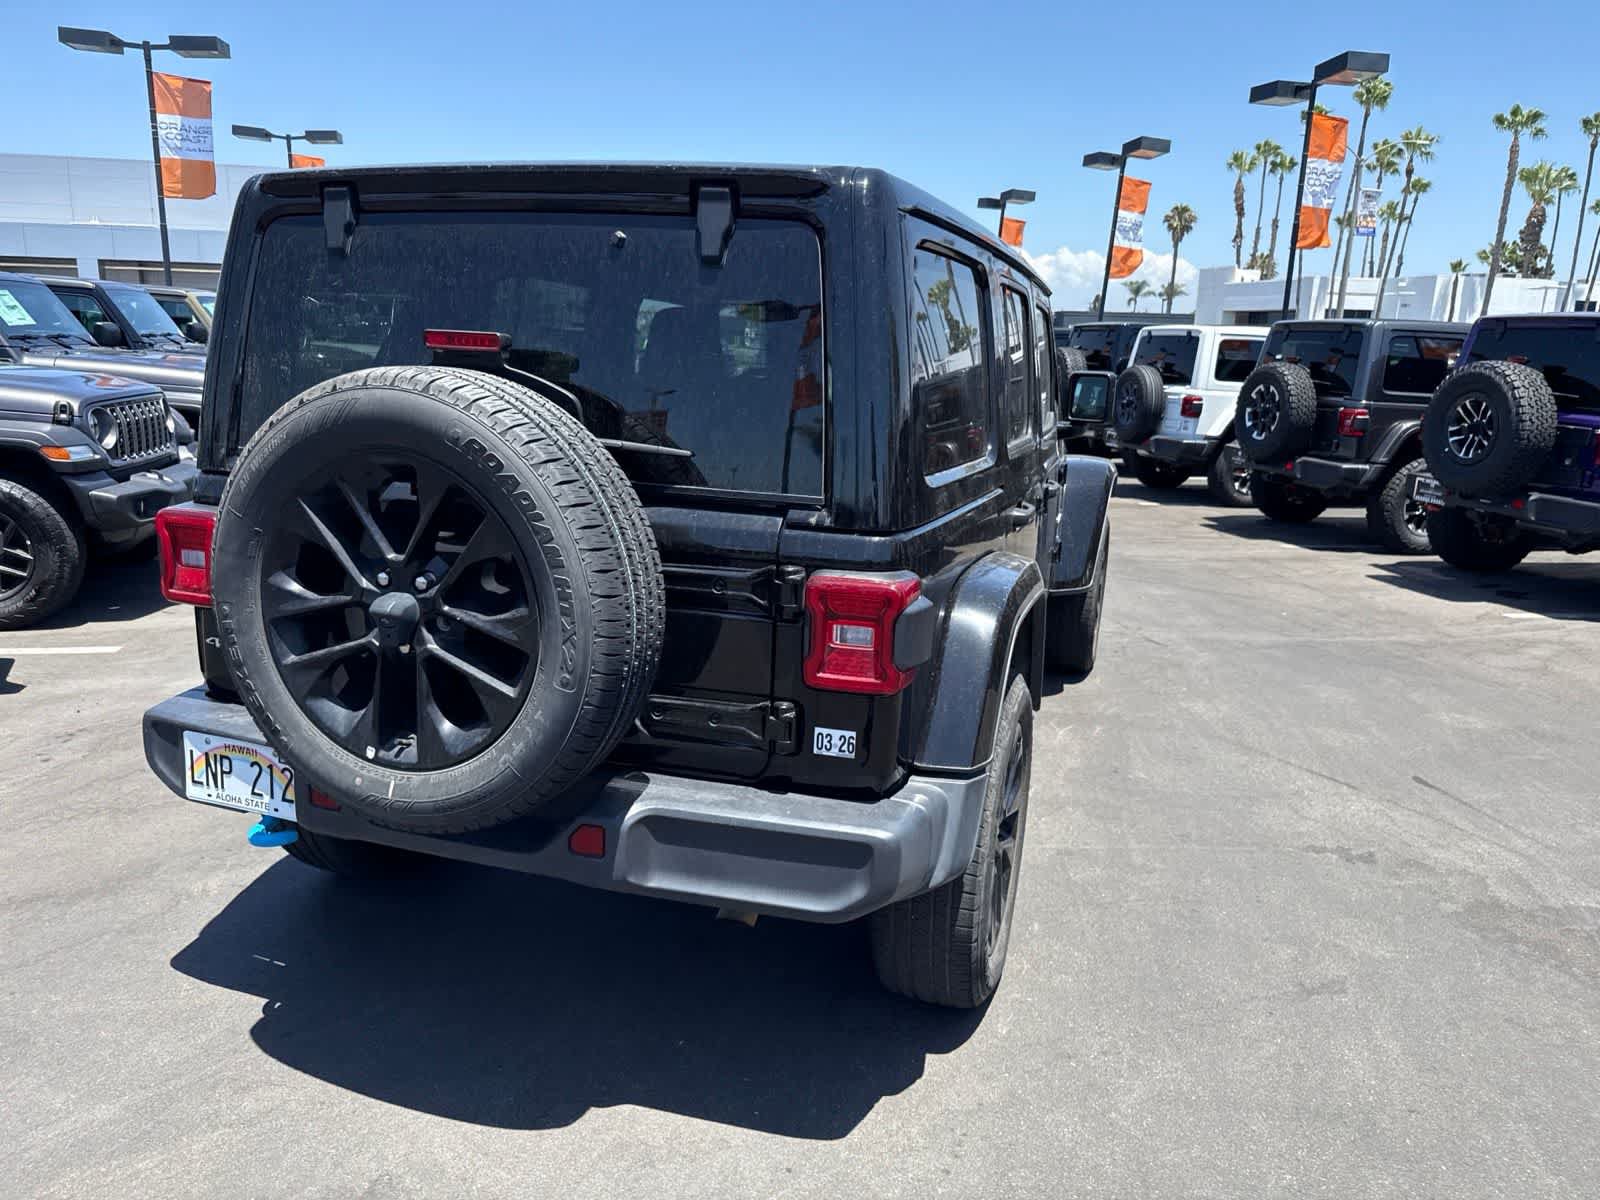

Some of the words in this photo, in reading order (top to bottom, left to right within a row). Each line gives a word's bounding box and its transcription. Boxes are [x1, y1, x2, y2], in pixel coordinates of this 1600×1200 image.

[224, 743, 259, 757] HAWAII
[189, 749, 233, 791] LNP
[250, 761, 295, 804] 212
[215, 792, 243, 805] ALOHA
[244, 799, 271, 811] STATE
